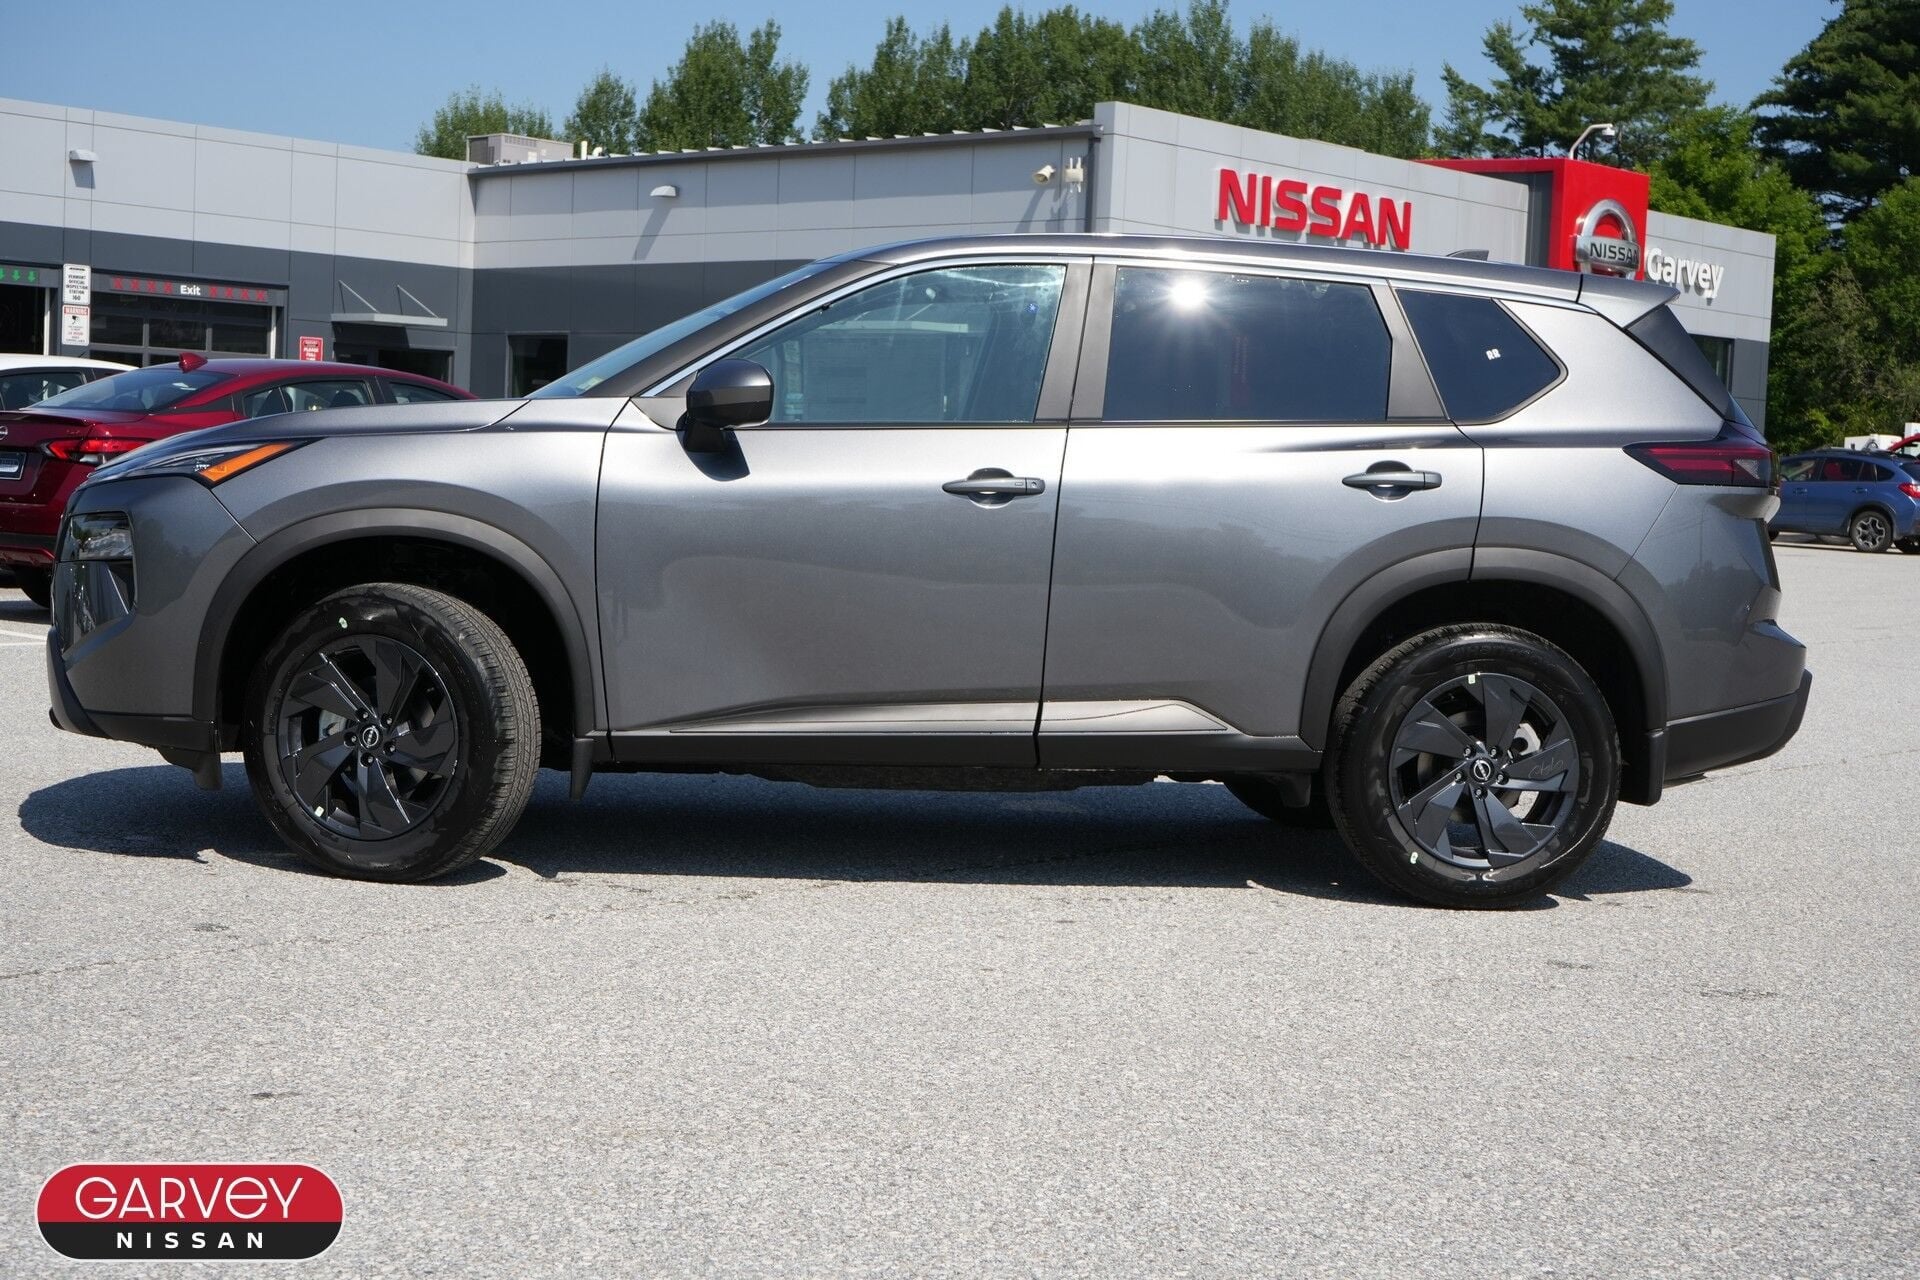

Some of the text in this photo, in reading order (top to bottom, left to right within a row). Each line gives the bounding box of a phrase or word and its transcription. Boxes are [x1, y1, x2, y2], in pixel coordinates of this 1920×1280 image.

[1218, 168, 1412, 250] NISSAN
[1589, 242, 1639, 265] NISSAN
[180, 284, 201, 296] Exit
[1646, 247, 1725, 300] Garvey
